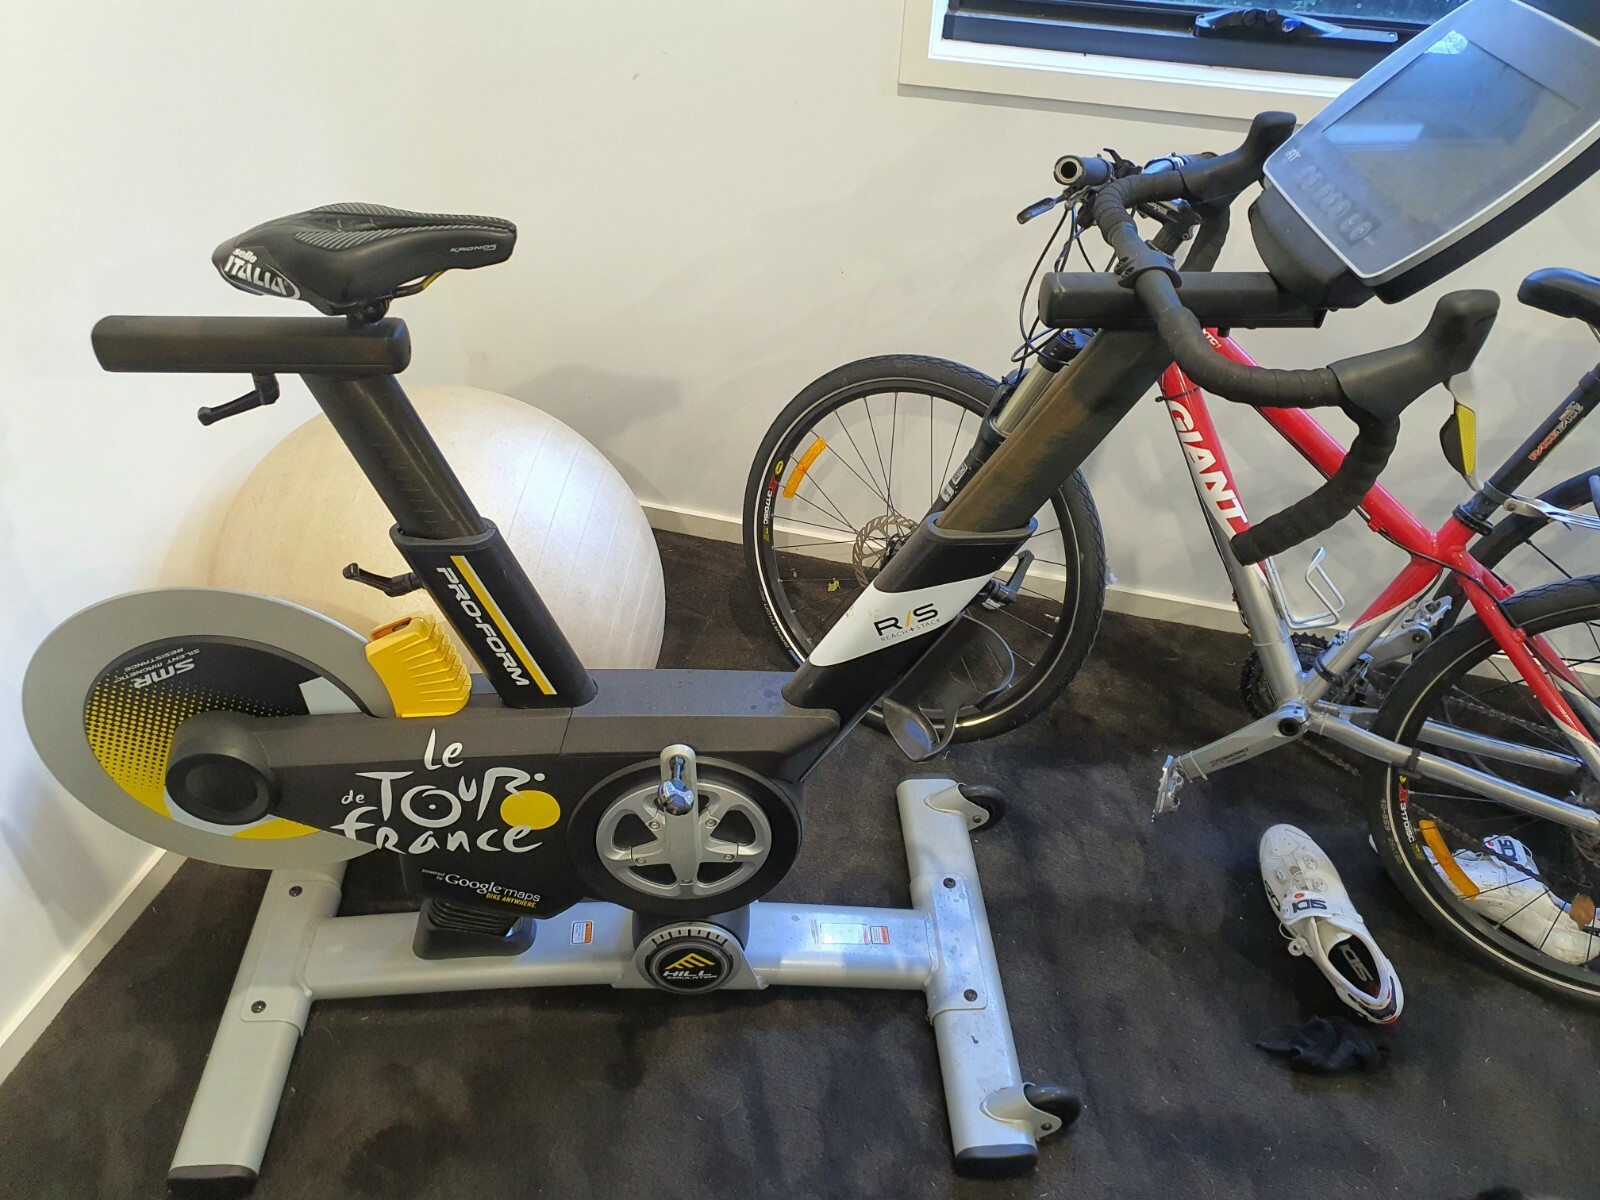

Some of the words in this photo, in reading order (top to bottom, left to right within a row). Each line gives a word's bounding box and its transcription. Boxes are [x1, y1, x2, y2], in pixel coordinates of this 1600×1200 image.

[449, 243, 497, 254] KRONOS
[223, 254, 289, 296] ITALIA
[1167, 400, 1249, 540] GIANT
[435, 566, 531, 687] PRO-FORM
[873, 602, 939, 637] R/S
[124, 646, 184, 672] RESISTANCE
[166, 647, 201, 665] SILENT
[115, 661, 164, 683] MAGNETIC
[133, 657, 196, 690] SMR
[340, 788, 366, 806] de
[421, 867, 446, 878] powered
[444, 873, 503, 896] Google
[503, 887, 542, 903] maps
[485, 892, 502, 902] BIKE
[1291, 898, 1328, 913] SIDI
[662, 970, 712, 978] HILL
[1337, 943, 1374, 982] SIDI
